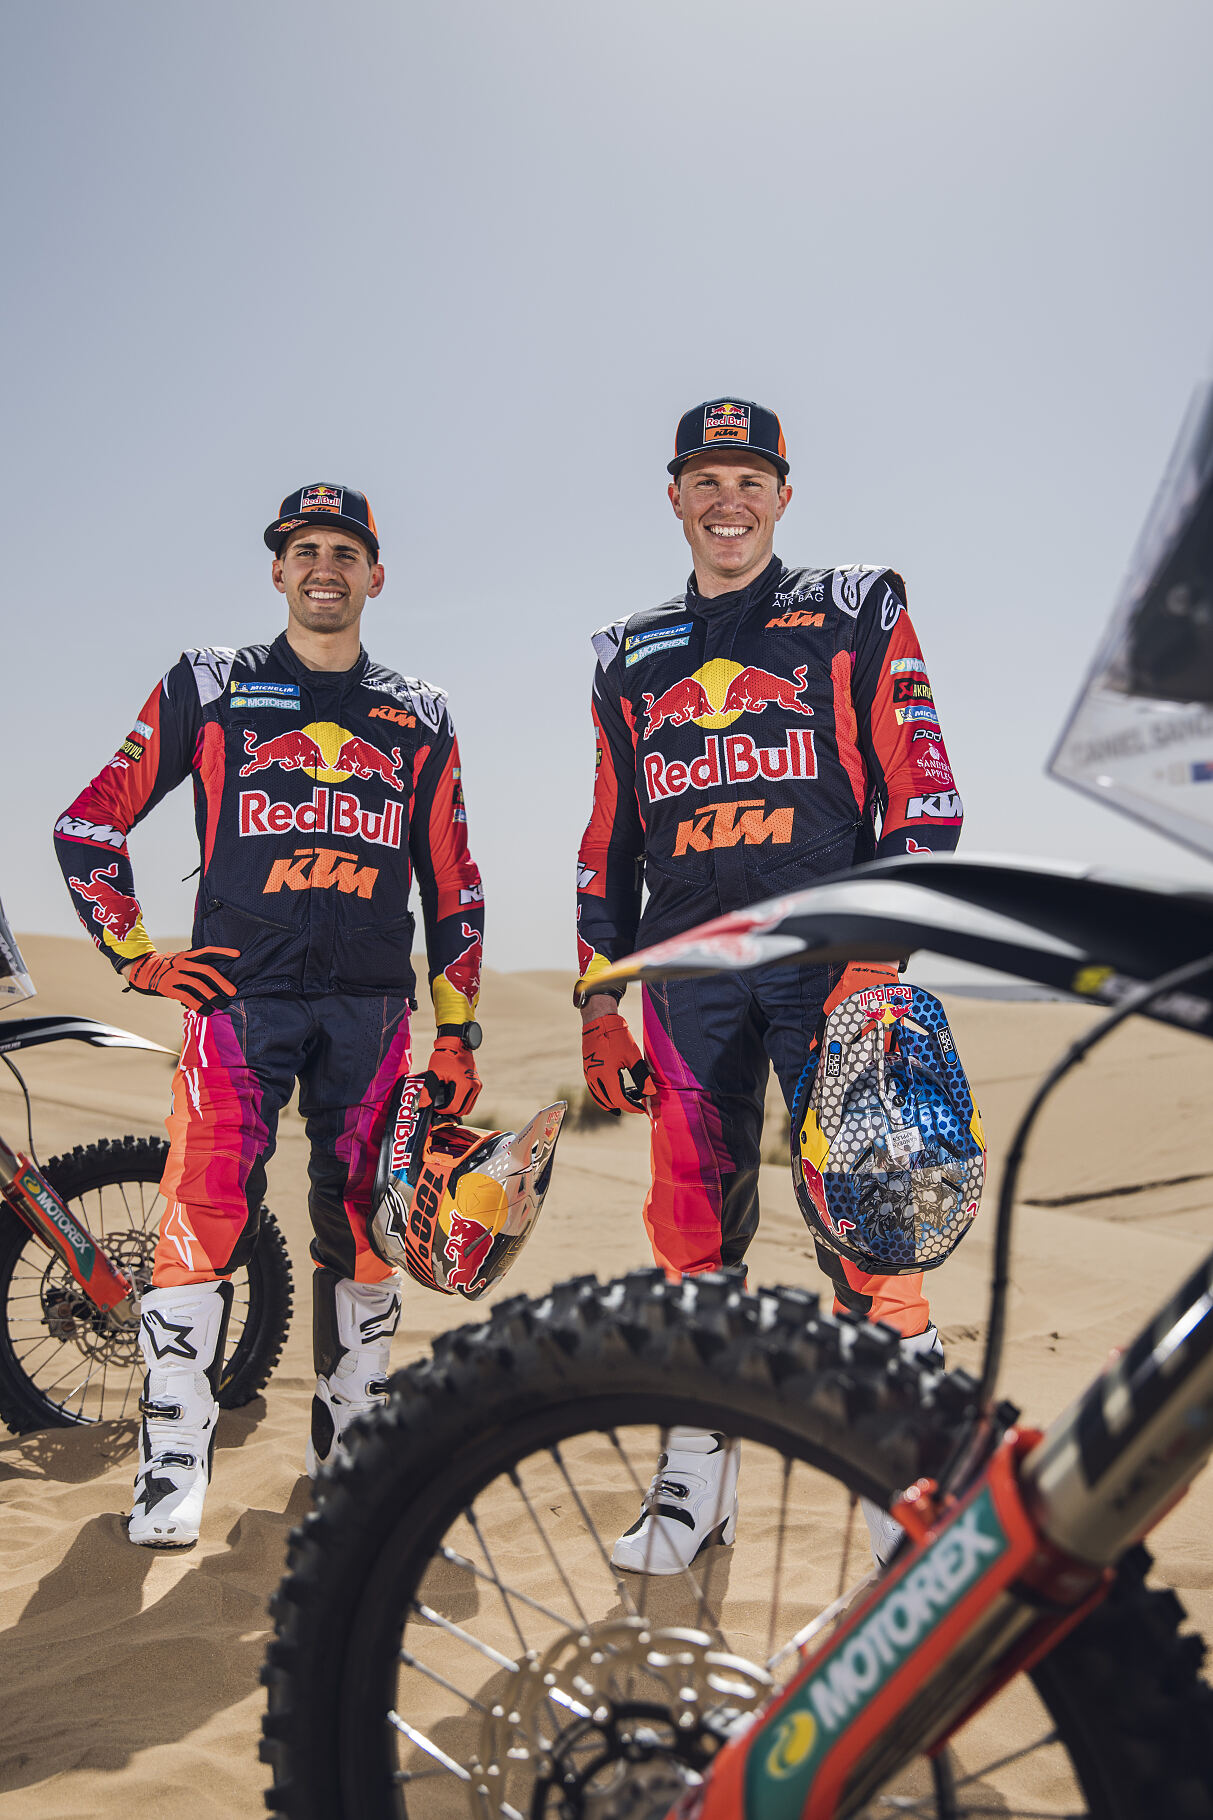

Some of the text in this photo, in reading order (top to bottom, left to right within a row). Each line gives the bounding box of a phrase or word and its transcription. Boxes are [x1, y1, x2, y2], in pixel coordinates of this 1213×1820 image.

[706, 415, 748, 428] Red Bull
[714, 428, 739, 437] KTM
[302, 495, 340, 507] Red Bull
[772, 592, 824, 608] AIR BAG
[765, 610, 826, 628] KTM
[642, 626, 688, 640] MICHELIN
[638, 638, 687, 658] MOTOREX
[250, 685, 294, 693] MICHELIN
[247, 698, 297, 709] MOTOREX
[368, 705, 417, 728] KTM
[644, 729, 818, 803] Red Bull
[239, 786, 403, 849] Red Bull
[54, 815, 126, 849] KTM
[672, 799, 795, 858] KTM
[262, 847, 380, 900] KTM
[859, 986, 913, 1007] Red Bull
[392, 1078, 426, 1171] Red Bull
[36, 1191, 90, 1254] MOTOREX
[808, 1511, 997, 1731] MOTOREX
